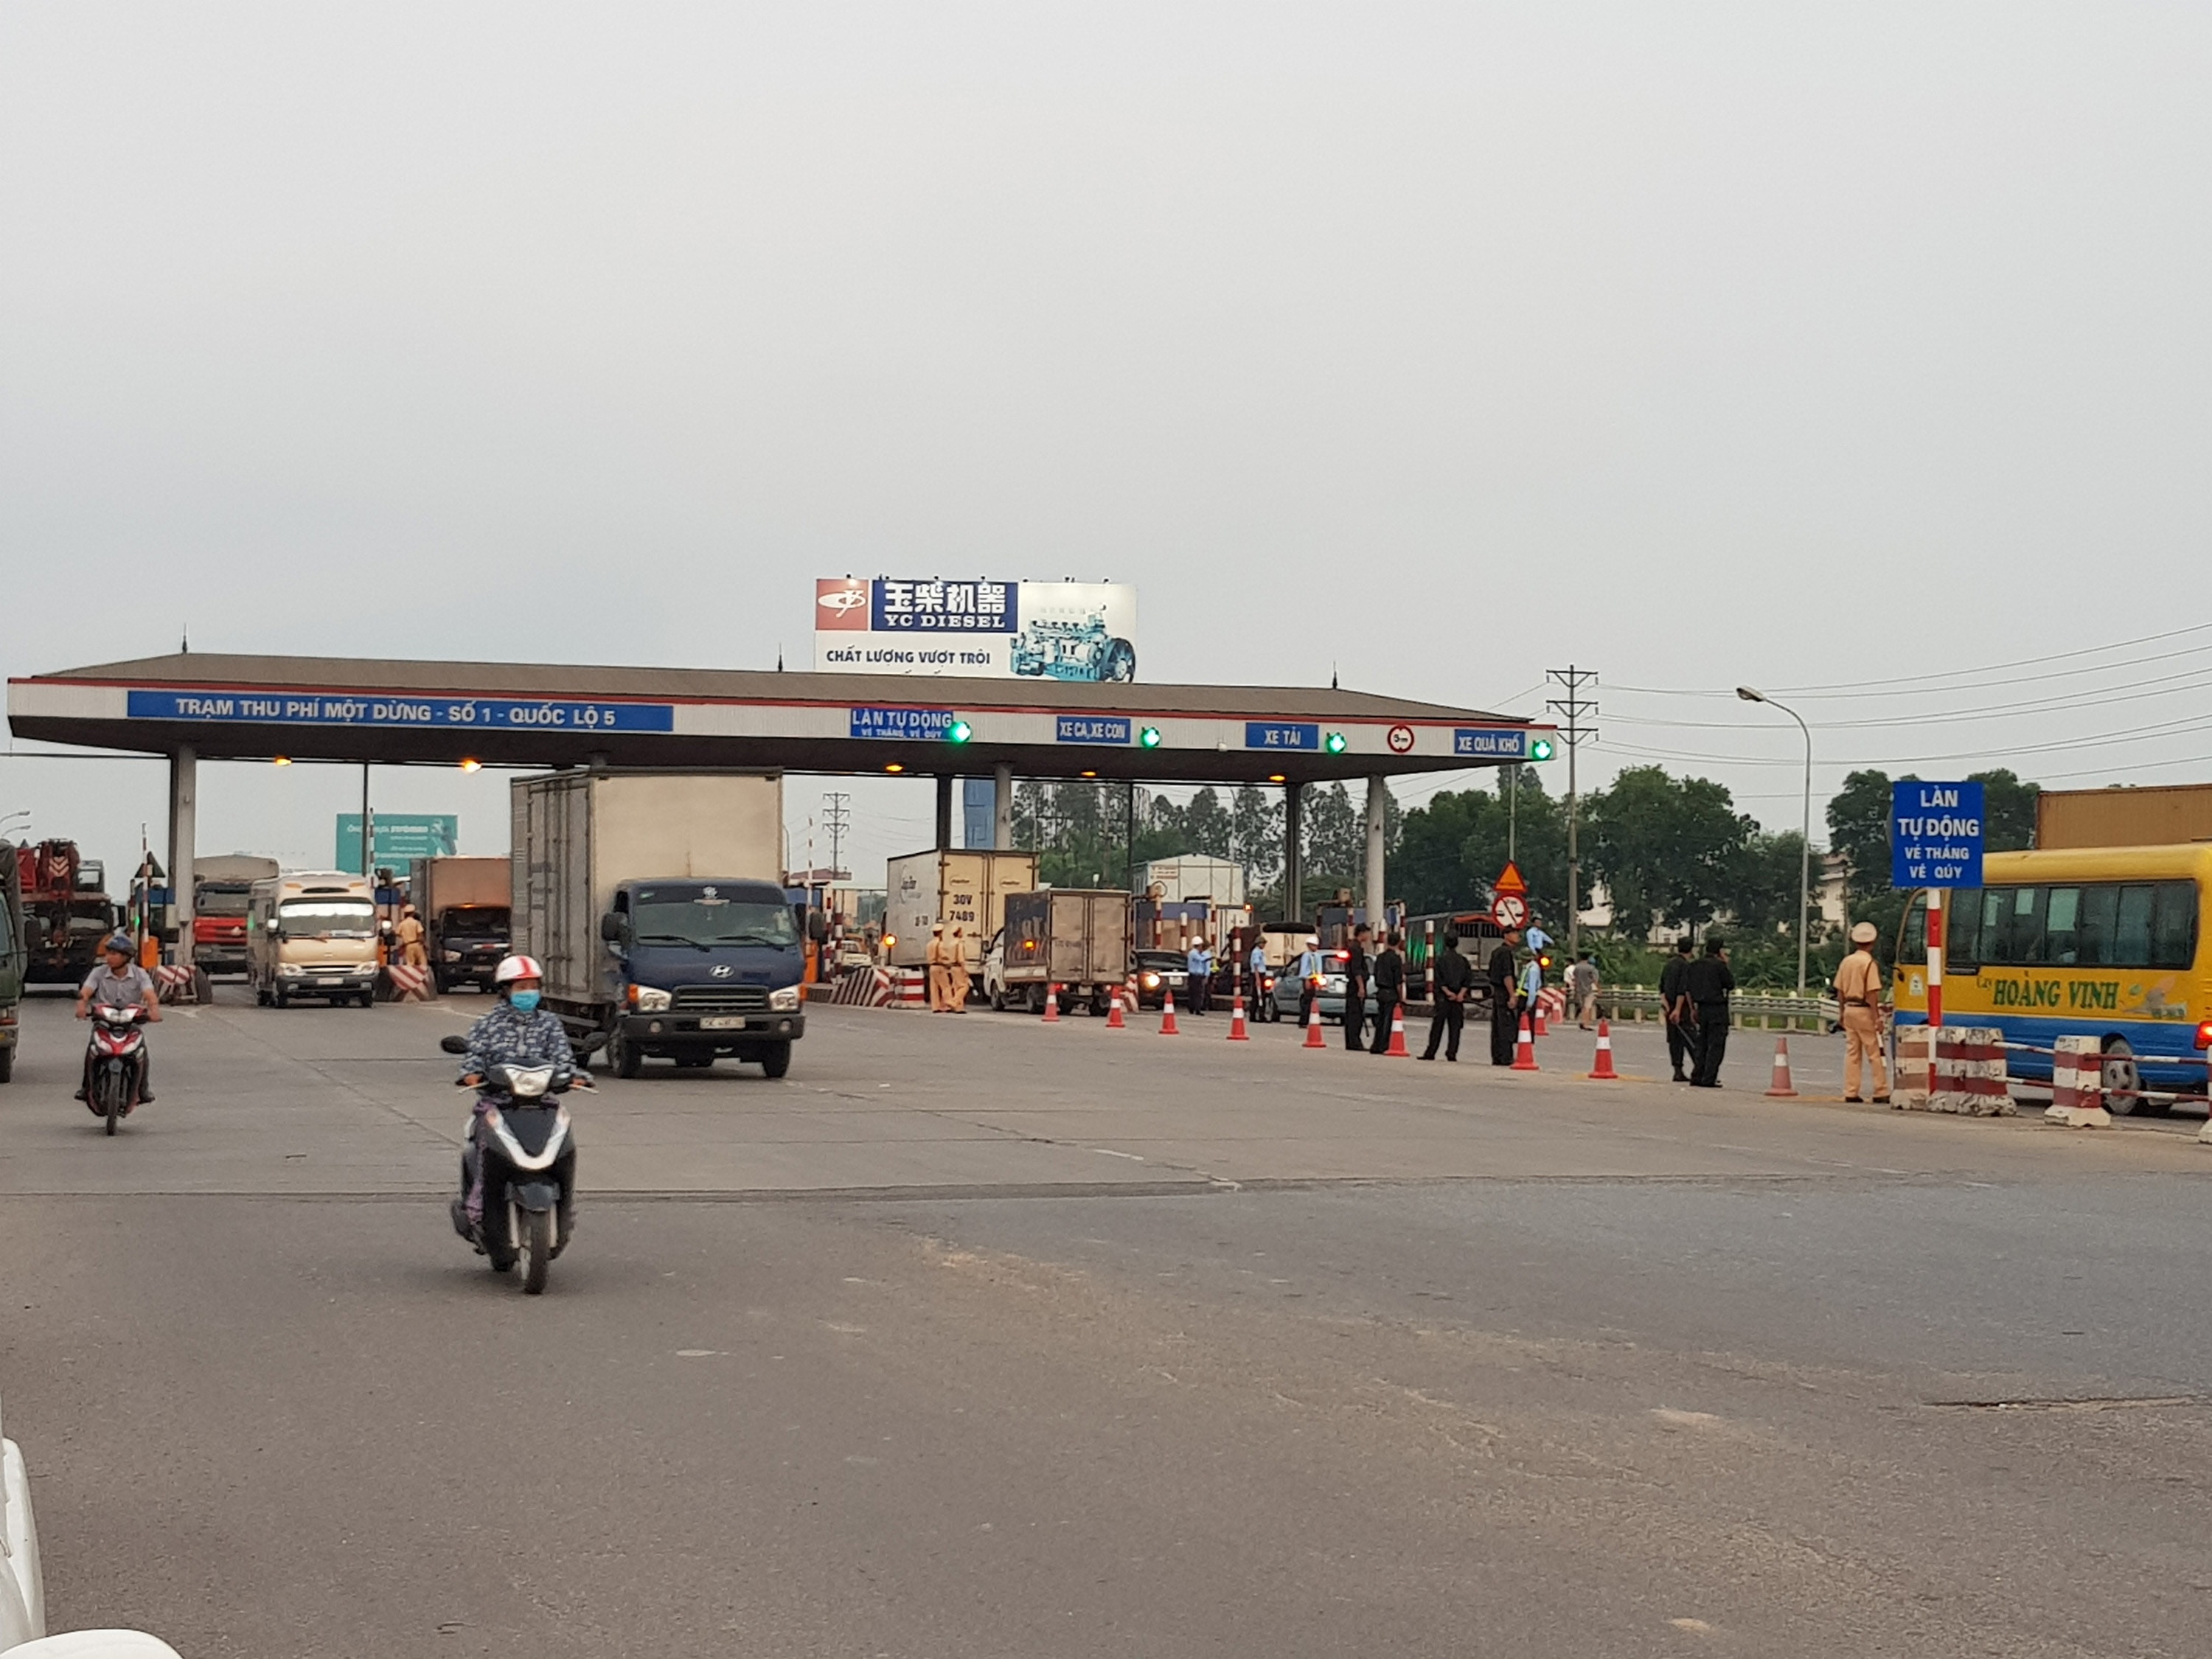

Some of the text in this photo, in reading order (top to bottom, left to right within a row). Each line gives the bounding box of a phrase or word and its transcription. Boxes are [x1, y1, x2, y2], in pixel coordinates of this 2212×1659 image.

[885, 582, 1006, 613] 玉柴机器
[885, 614, 1006, 628] YC DIESEL
[827, 644, 990, 667] CHẤT LƯỢNG VƯỢT TRỘI
[175, 698, 234, 719] TRẠM
[240, 700, 280, 717] THU
[286, 698, 320, 718] PHÍ
[325, 699, 368, 722] MỘT
[373, 700, 431, 721] DỪNG
[448, 700, 477, 722] SỐ
[481, 707, 491, 723] 1
[509, 702, 566, 725] QUỐC
[573, 706, 599, 728] LỘ
[604, 710, 616, 726] 5
[852, 709, 952, 729] LÀN TỰ ĐỘNG
[1060, 722, 1073, 736] XE
[1264, 726, 1301, 745] XE TẢI
[1458, 737, 1472, 751] XE
[1475, 734, 1496, 751] QUÁ
[1920, 785, 1958, 807] LÀN
[1896, 814, 1979, 841] TỰ ĐỘNG
[1905, 844, 1969, 860] VÉ THÁNG
[1909, 863, 1926, 878] VÉ
[1993, 970, 2120, 1009] HOÀNG VINH
